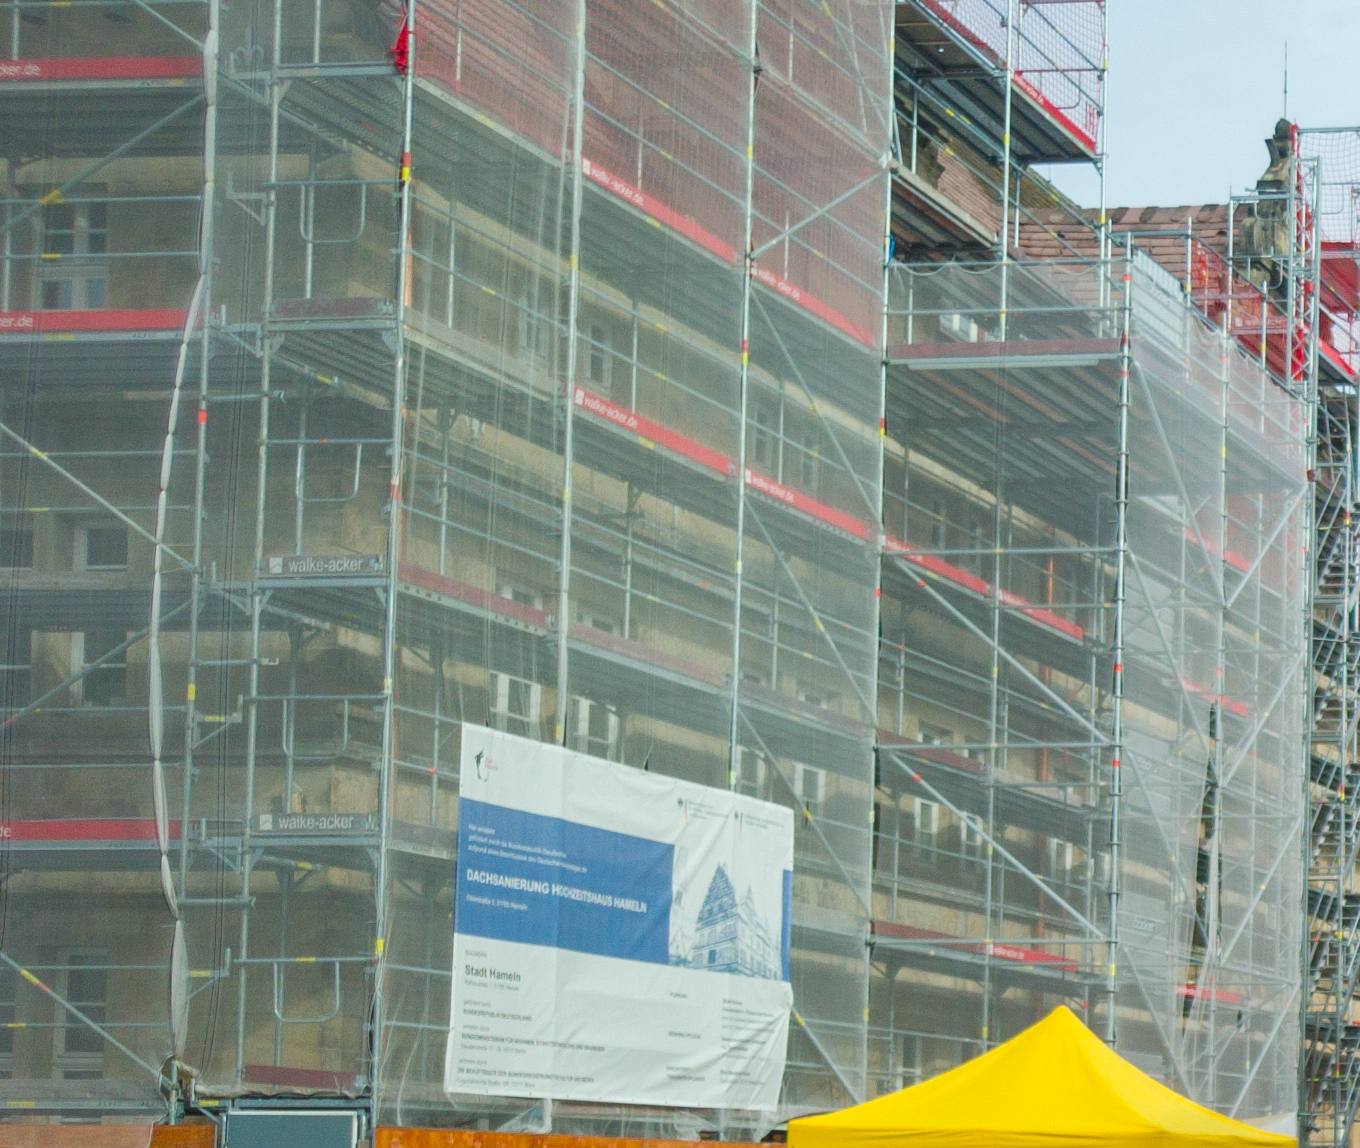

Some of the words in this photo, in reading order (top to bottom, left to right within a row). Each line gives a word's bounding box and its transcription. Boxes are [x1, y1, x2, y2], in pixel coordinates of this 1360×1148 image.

[288, 556, 363, 573] walke-acker
[278, 814, 354, 830] walke-acker
[466, 868, 550, 895] DACHSANIERUNG
[551, 883, 613, 908] HOCHZEITSHAUS
[613, 896, 648, 914] HAMELN
[465, 964, 488, 978] Stadt
[489, 968, 522, 982] Hameln
